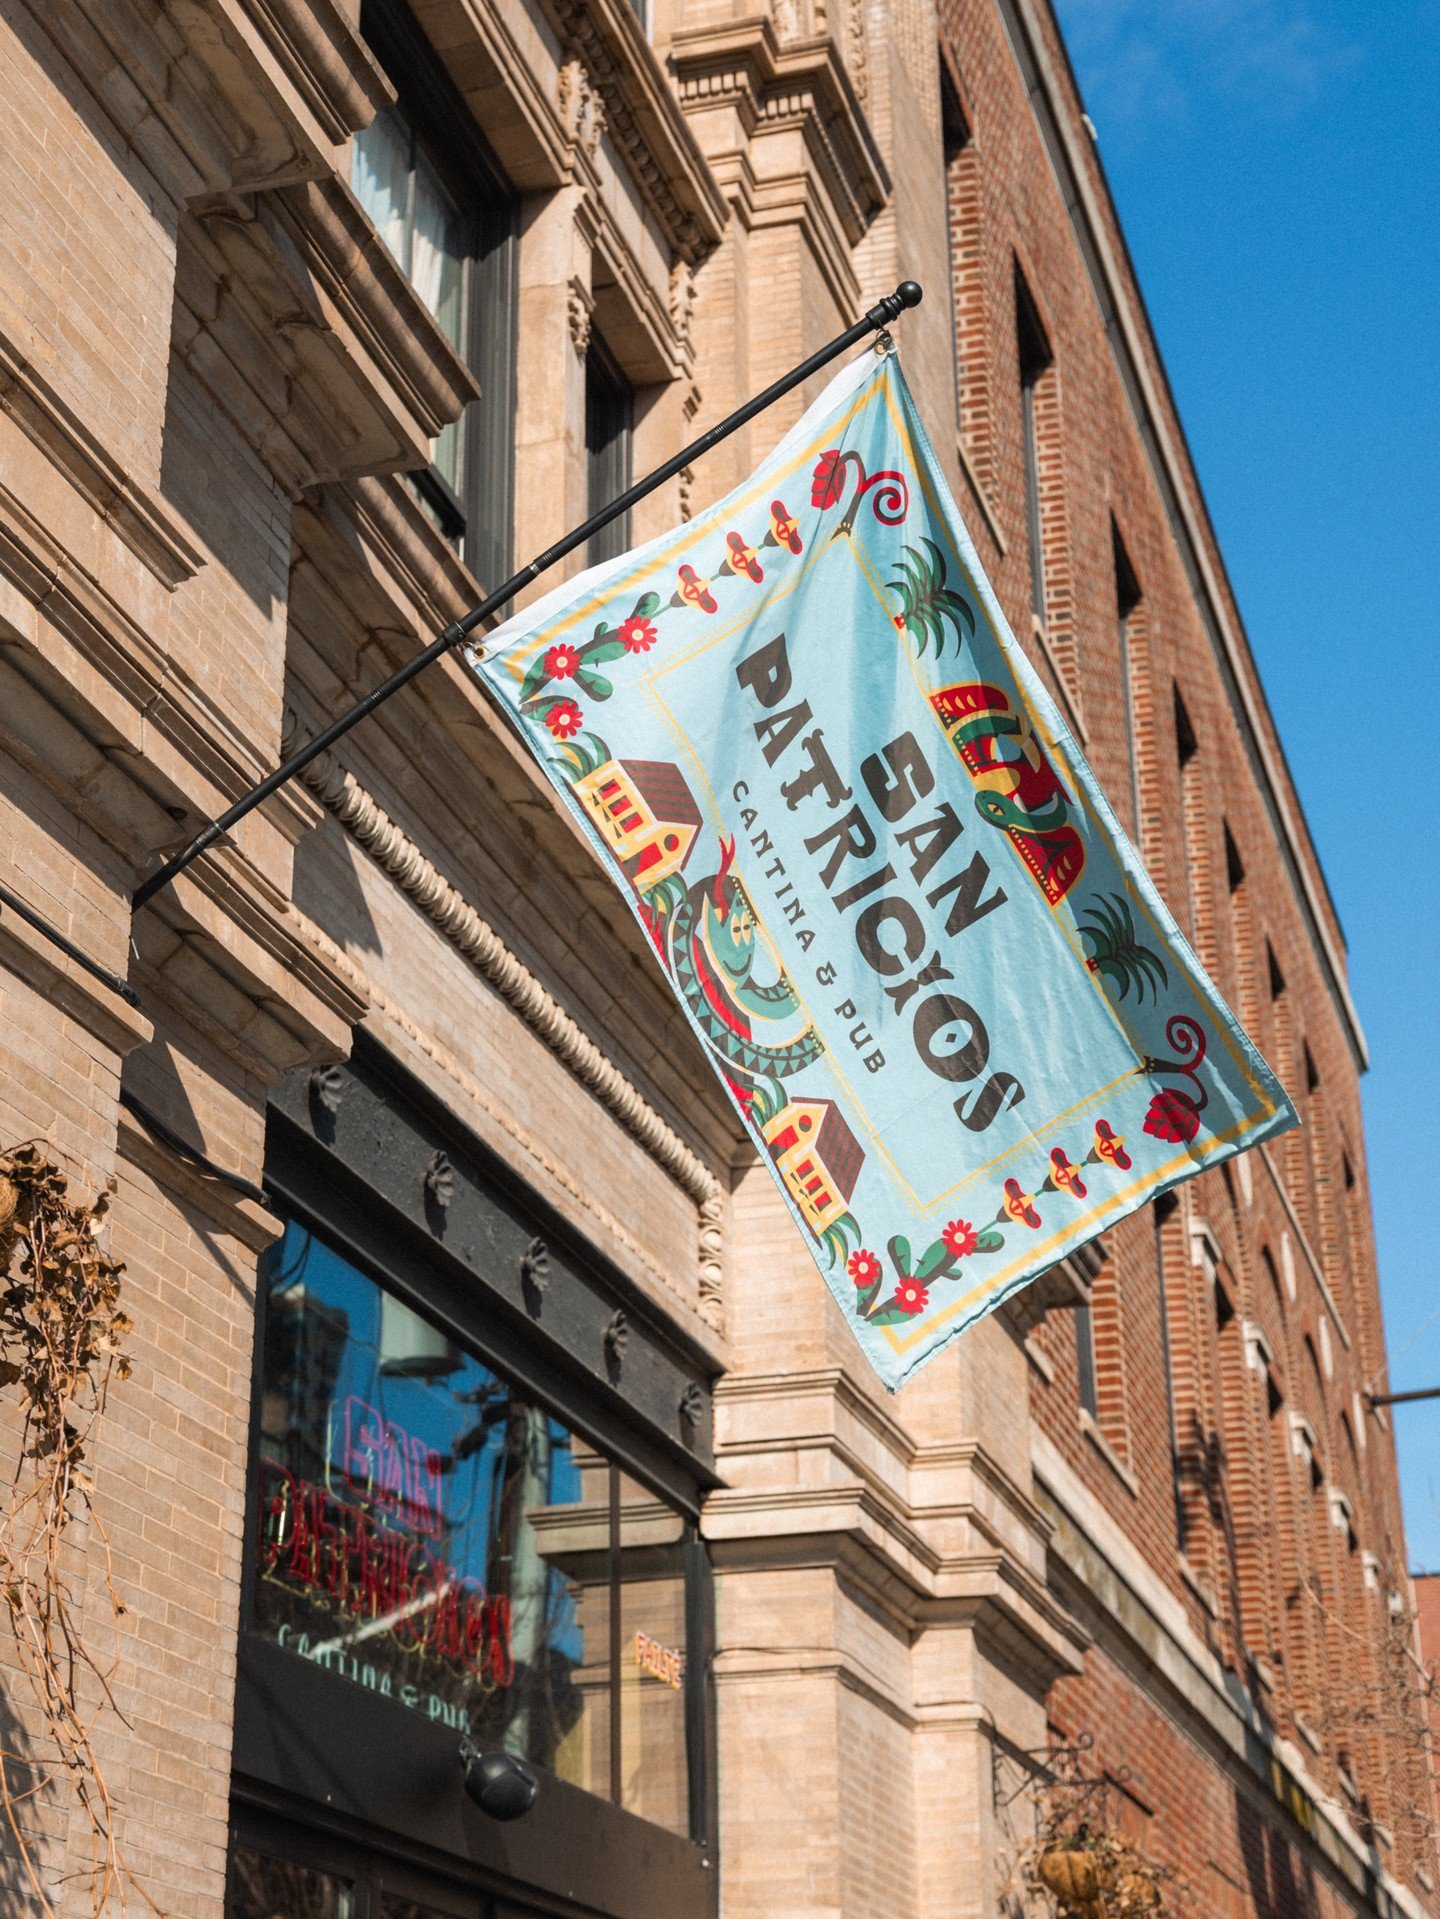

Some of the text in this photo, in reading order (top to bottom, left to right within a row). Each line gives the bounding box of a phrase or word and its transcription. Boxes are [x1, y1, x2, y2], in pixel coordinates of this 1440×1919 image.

[732, 780, 886, 1074] CANTINA & PUB
[735, 632, 1026, 1133] PATRICIOS
[860, 731, 1008, 938] SAN
